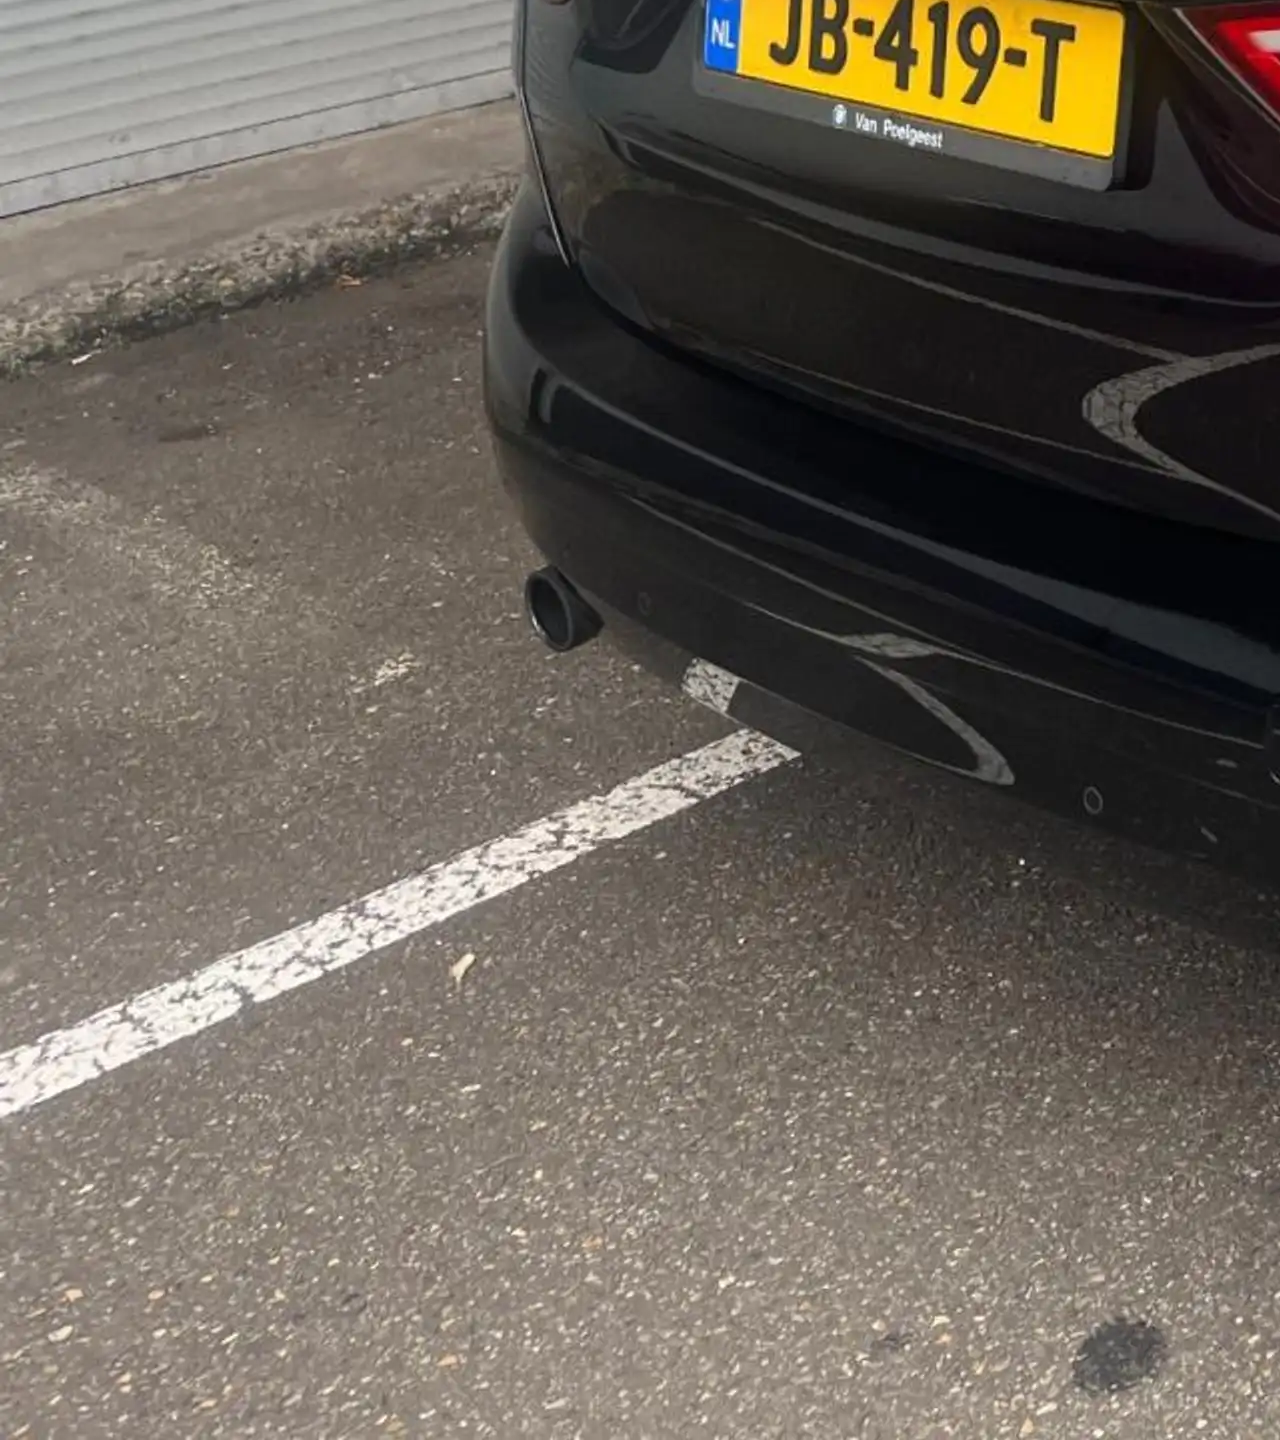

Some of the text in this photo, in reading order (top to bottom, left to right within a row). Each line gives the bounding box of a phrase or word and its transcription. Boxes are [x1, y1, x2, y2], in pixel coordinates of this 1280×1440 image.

[710, 18, 736, 50] NL
[855, 111, 943, 149] Van Poelgeest
